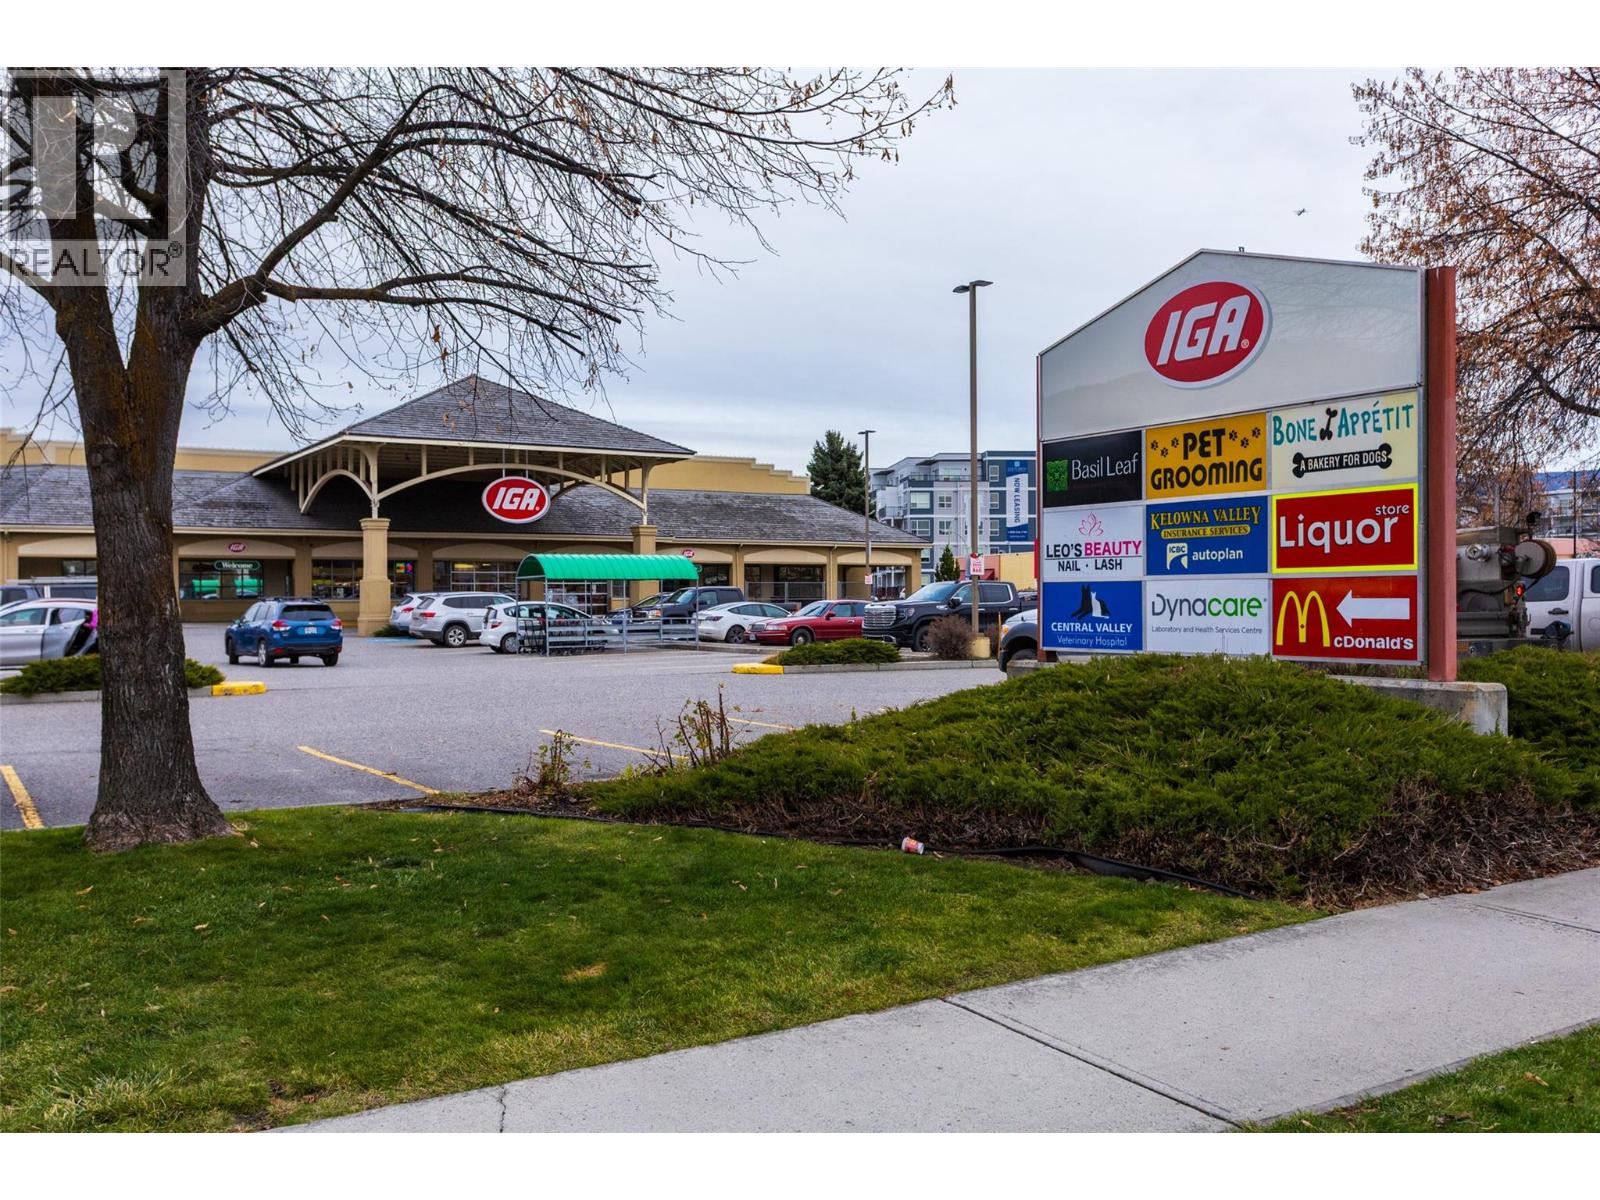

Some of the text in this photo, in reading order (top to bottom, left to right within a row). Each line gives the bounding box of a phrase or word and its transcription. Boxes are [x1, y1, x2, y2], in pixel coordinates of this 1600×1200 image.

[1273, 400, 1414, 446] BONE APPÉTIT
[1182, 428, 1226, 460] PET
[1072, 452, 1138, 480] Basil Leaf
[1300, 450, 1388, 471] A BAKERY FOR DOGS
[1151, 458, 1262, 490] GROOMING
[1013, 477, 1021, 493] NOW
[1013, 495, 1021, 523] LEASING
[1375, 504, 1410, 516] store
[1150, 506, 1261, 530] KELOWNA VALLEY
[1163, 525, 1248, 538] INSURANCE SERVICES
[1279, 514, 1399, 554] Liquor
[1046, 540, 1142, 558] LEO'S BEAUTY
[1168, 545, 1186, 553] ICBC
[1192, 548, 1244, 562] autoplan
[221, 561, 254, 569] Welcome
[1058, 559, 1122, 572] NAIL LASH
[1151, 593, 1262, 621] Dynacare
[1051, 621, 1133, 633] CENTRAL VALLEY
[1151, 625, 1181, 633] Laboratory
[1215, 626, 1240, 634] Services
[1241, 626, 1262, 634] Centre
[1056, 634, 1128, 648] Veterinary Hospital
